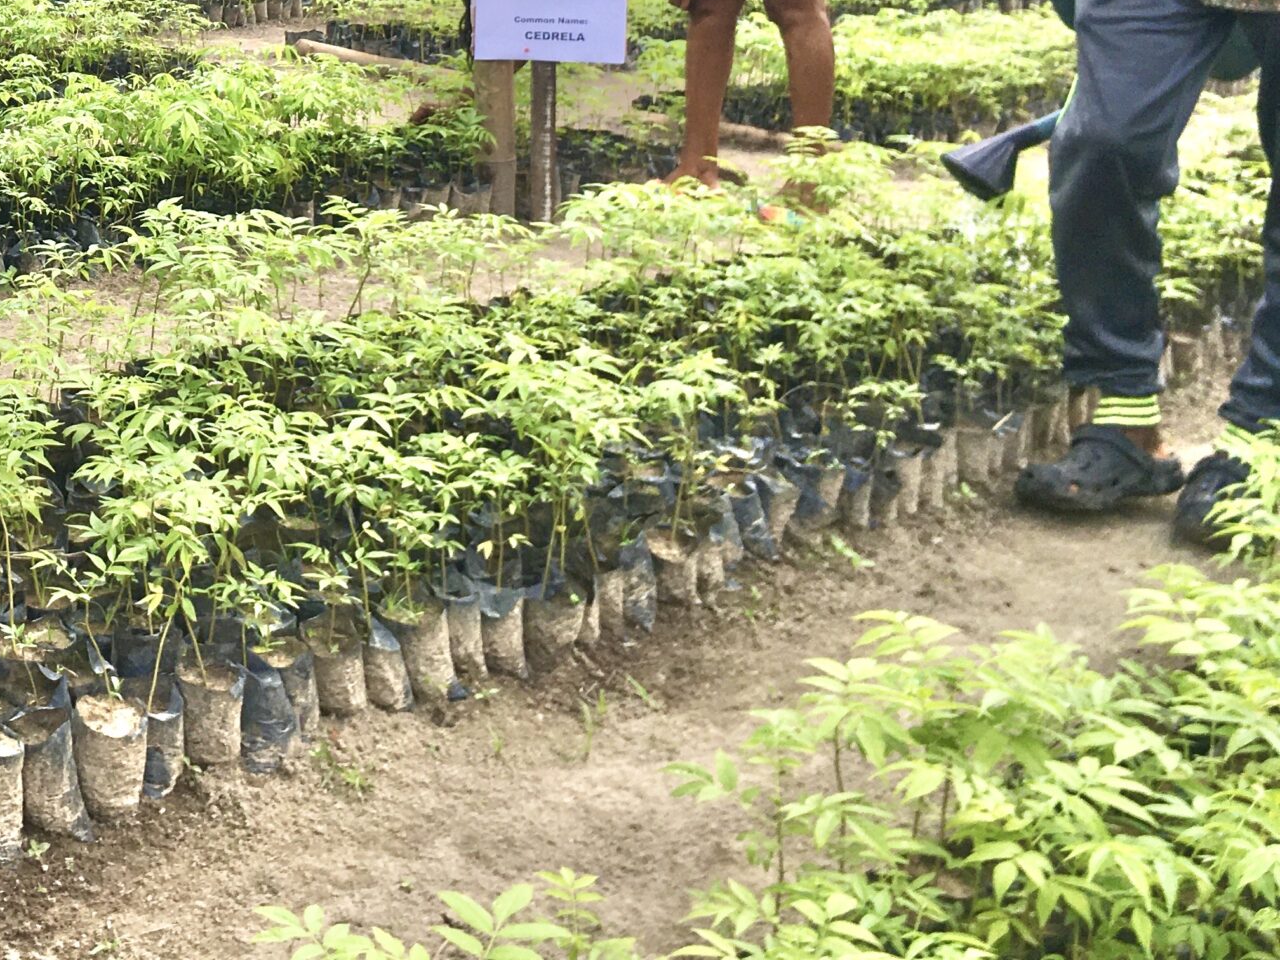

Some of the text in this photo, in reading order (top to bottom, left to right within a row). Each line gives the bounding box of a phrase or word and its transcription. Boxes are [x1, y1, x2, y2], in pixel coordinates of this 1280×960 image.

[514, 16, 588, 25] Common Name:
[524, 31, 585, 42] CEDRELA
